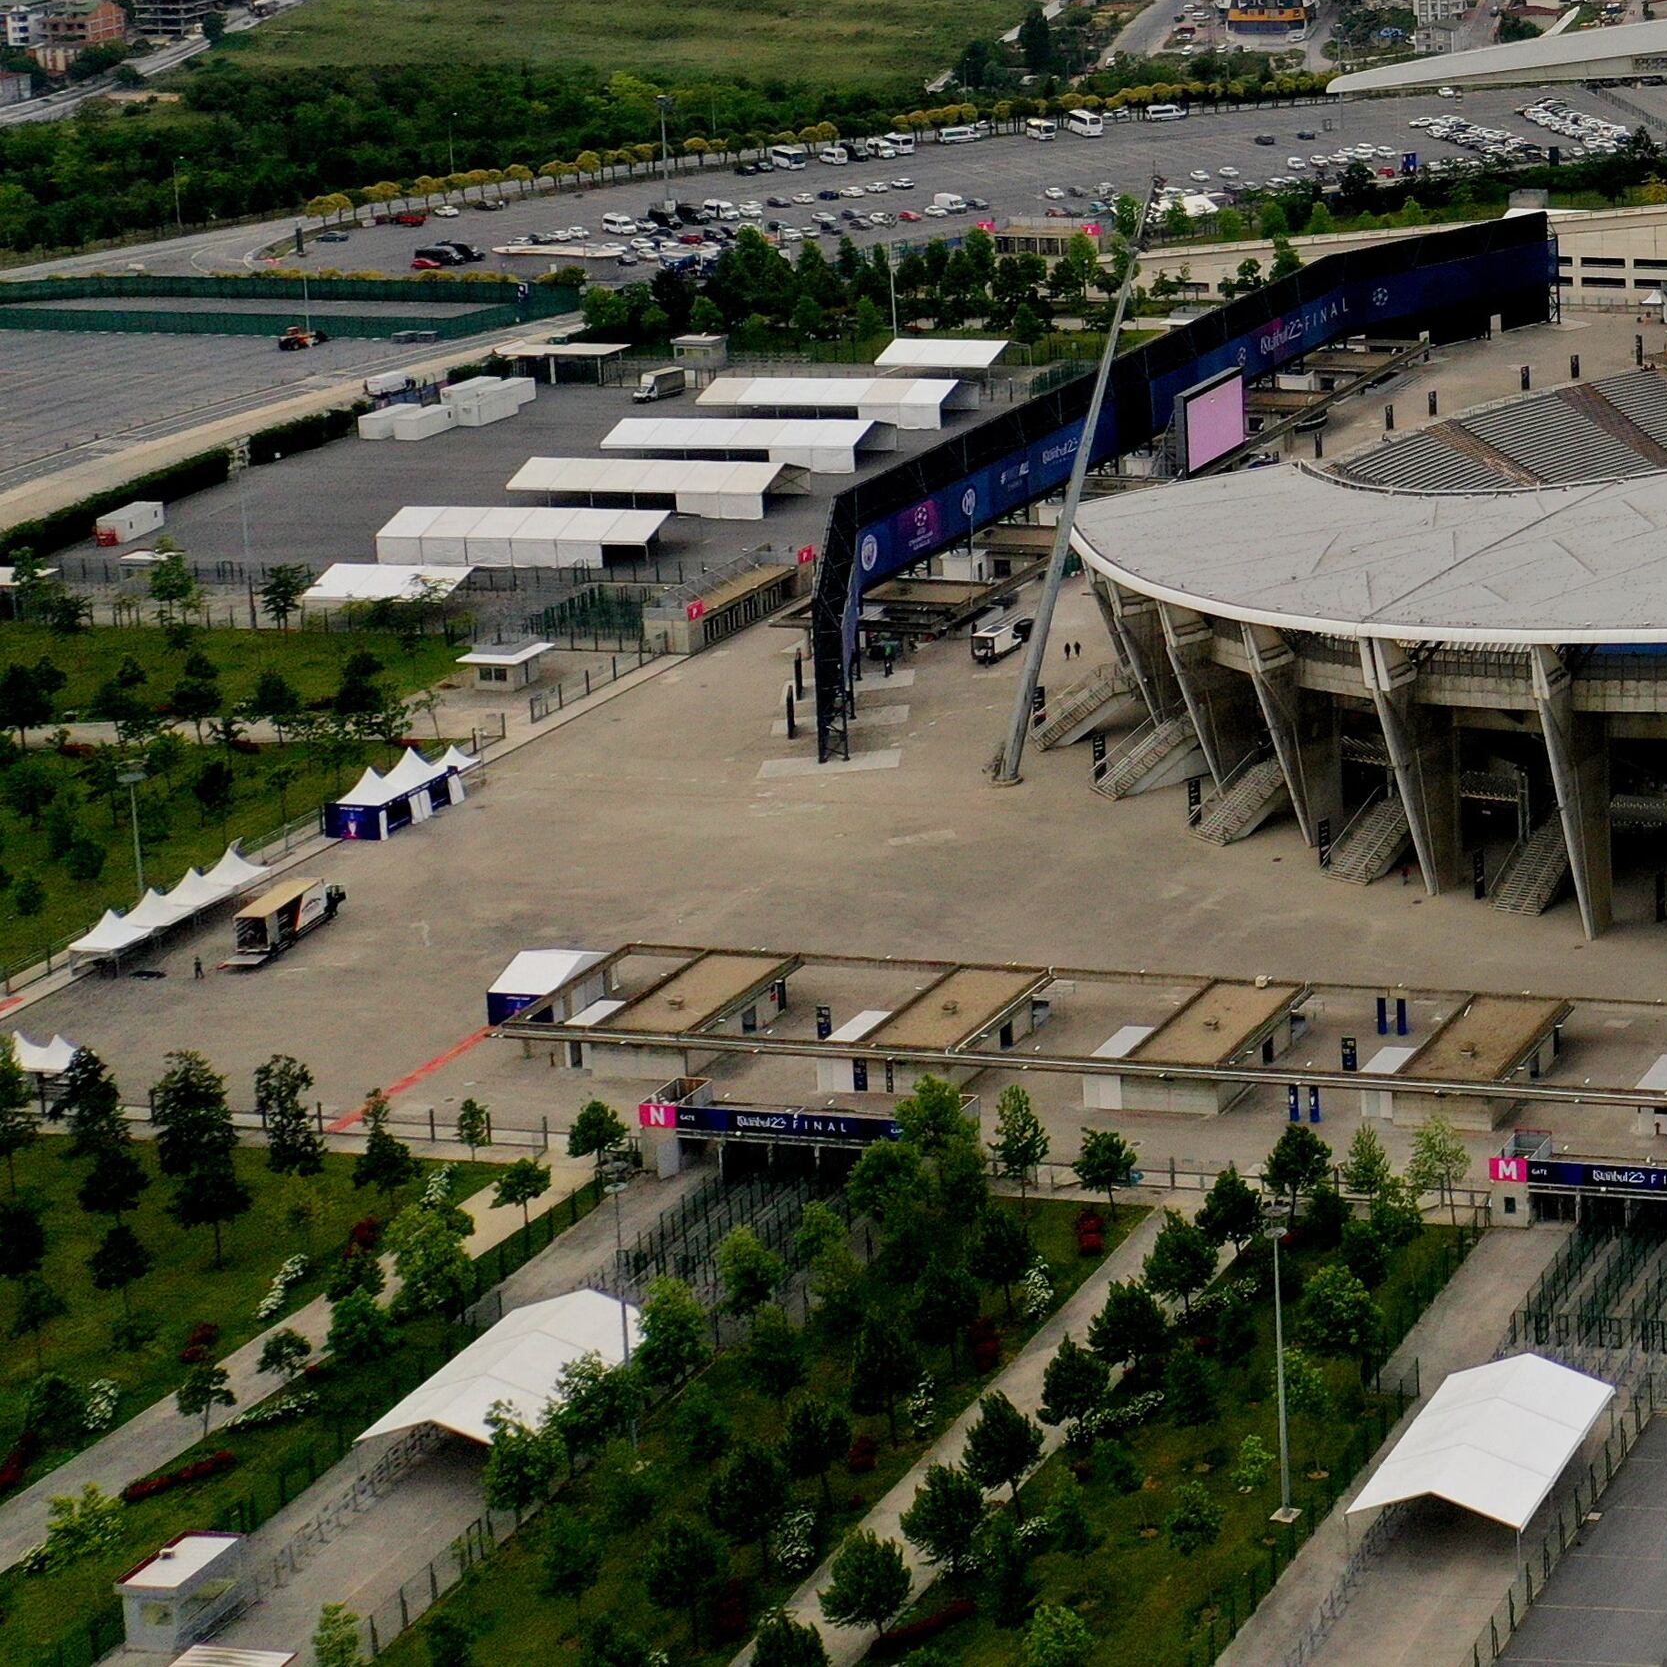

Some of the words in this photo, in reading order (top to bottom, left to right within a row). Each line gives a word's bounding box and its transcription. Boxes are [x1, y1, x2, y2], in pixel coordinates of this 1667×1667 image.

[1304, 297, 1349, 332] FINAL
[650, 1105, 666, 1126] N
[680, 1114, 696, 1122] GATE
[792, 1119, 848, 1133] FINAL
[1498, 1160, 1518, 1181] M
[1531, 1168, 1548, 1176] GATE
